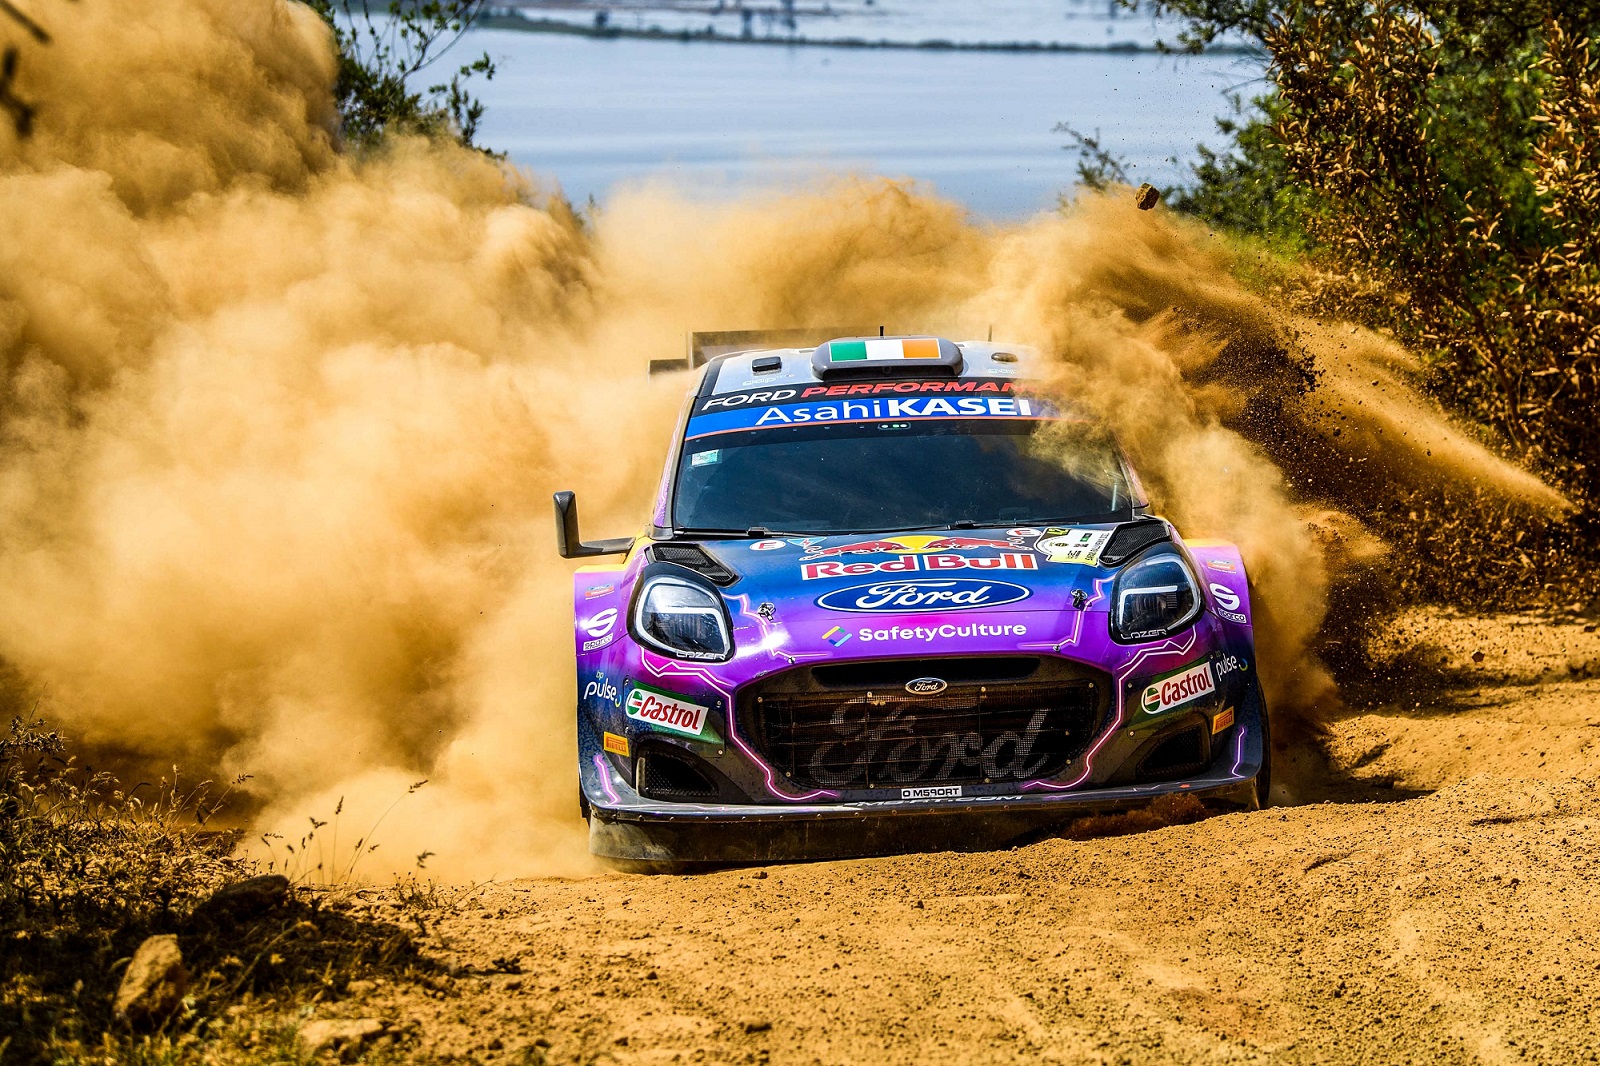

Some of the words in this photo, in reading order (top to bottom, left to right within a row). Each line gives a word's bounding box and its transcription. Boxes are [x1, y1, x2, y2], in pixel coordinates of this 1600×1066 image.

[701, 388, 797, 411] FORD
[801, 379, 1045, 399] PERFORMAN
[804, 556, 914, 578] Red
[928, 554, 1036, 570] Bull
[855, 583, 990, 608] Ford
[858, 623, 1027, 642] SafetyCulture
[1215, 652, 1238, 682] pulse
[583, 678, 617, 702] pulse
[914, 679, 939, 692] Ford
[1160, 669, 1213, 706] Castrol
[640, 694, 702, 731] Castrol
[809, 694, 1050, 787] Ford
